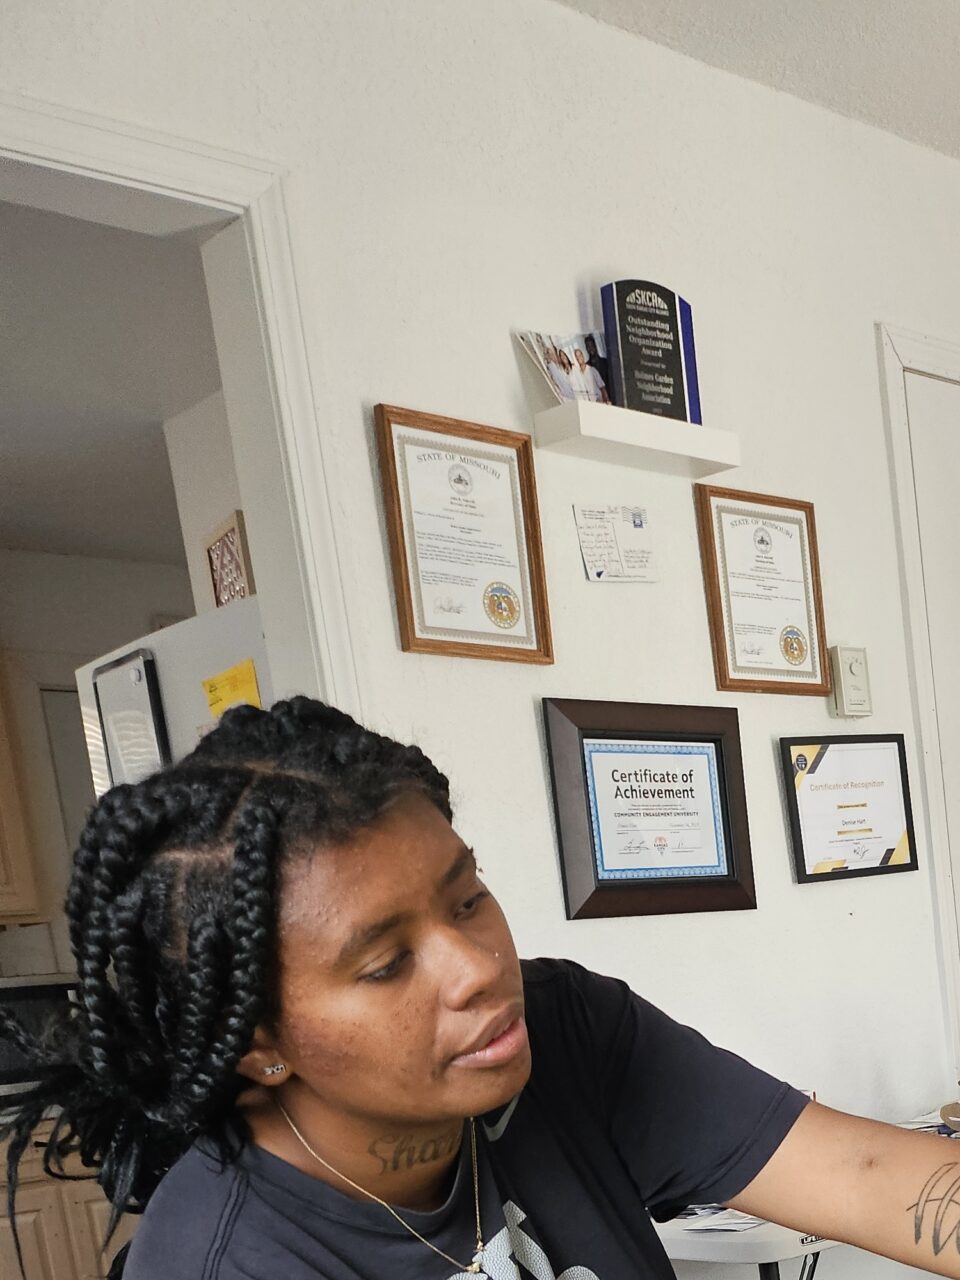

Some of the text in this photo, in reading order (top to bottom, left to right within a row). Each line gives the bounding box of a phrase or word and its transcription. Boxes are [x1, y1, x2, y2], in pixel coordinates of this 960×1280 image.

[634, 288, 659, 306] SKCA
[627, 315, 670, 331] Outstanding
[626, 324, 674, 341] Neighborhood
[628, 335, 673, 350] Organization
[641, 346, 663, 358] Award
[654, 373, 674, 385] Garden
[416, 452, 502, 480] STATE OF MISSOURI
[730, 518, 794, 540] STATE OF MISSOURI
[611, 769, 694, 783] Certificate of
[614, 785, 695, 799] Achievement
[810, 780, 885, 792] Certificate of Recognition
